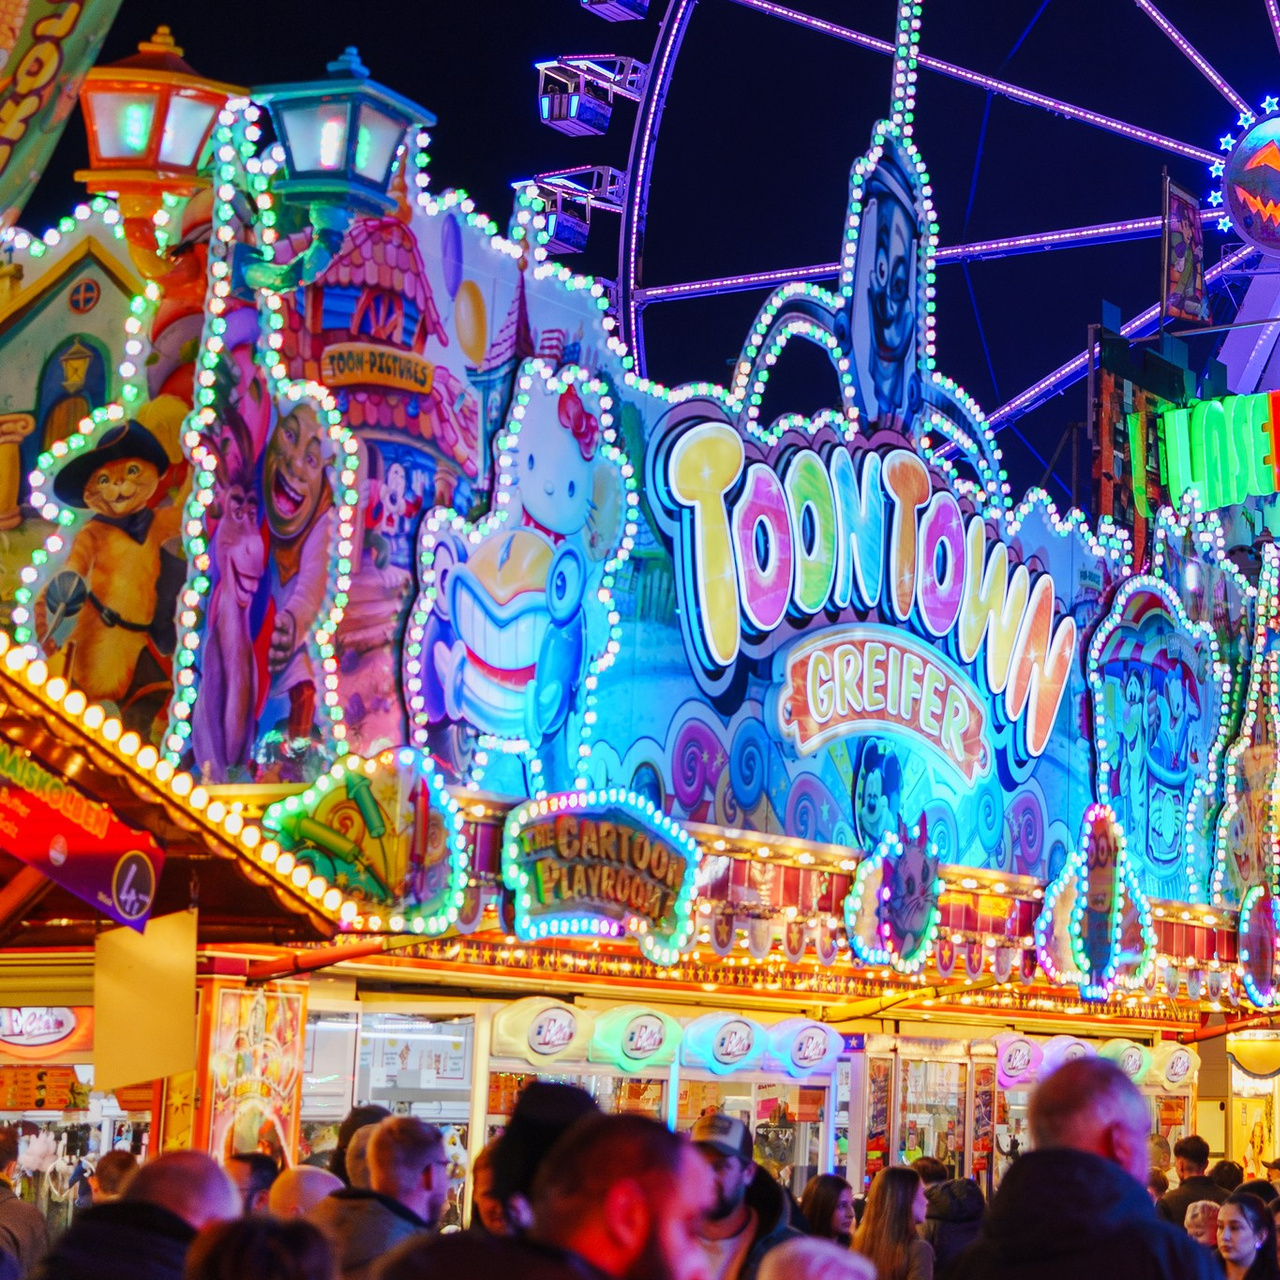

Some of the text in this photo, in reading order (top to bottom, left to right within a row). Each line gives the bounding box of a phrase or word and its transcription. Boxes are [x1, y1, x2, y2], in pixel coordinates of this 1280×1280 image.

[668, 421, 1078, 757] TOONTOWN
[806, 641, 970, 763] GREIFER
[555, 814, 687, 891] CARTOON
